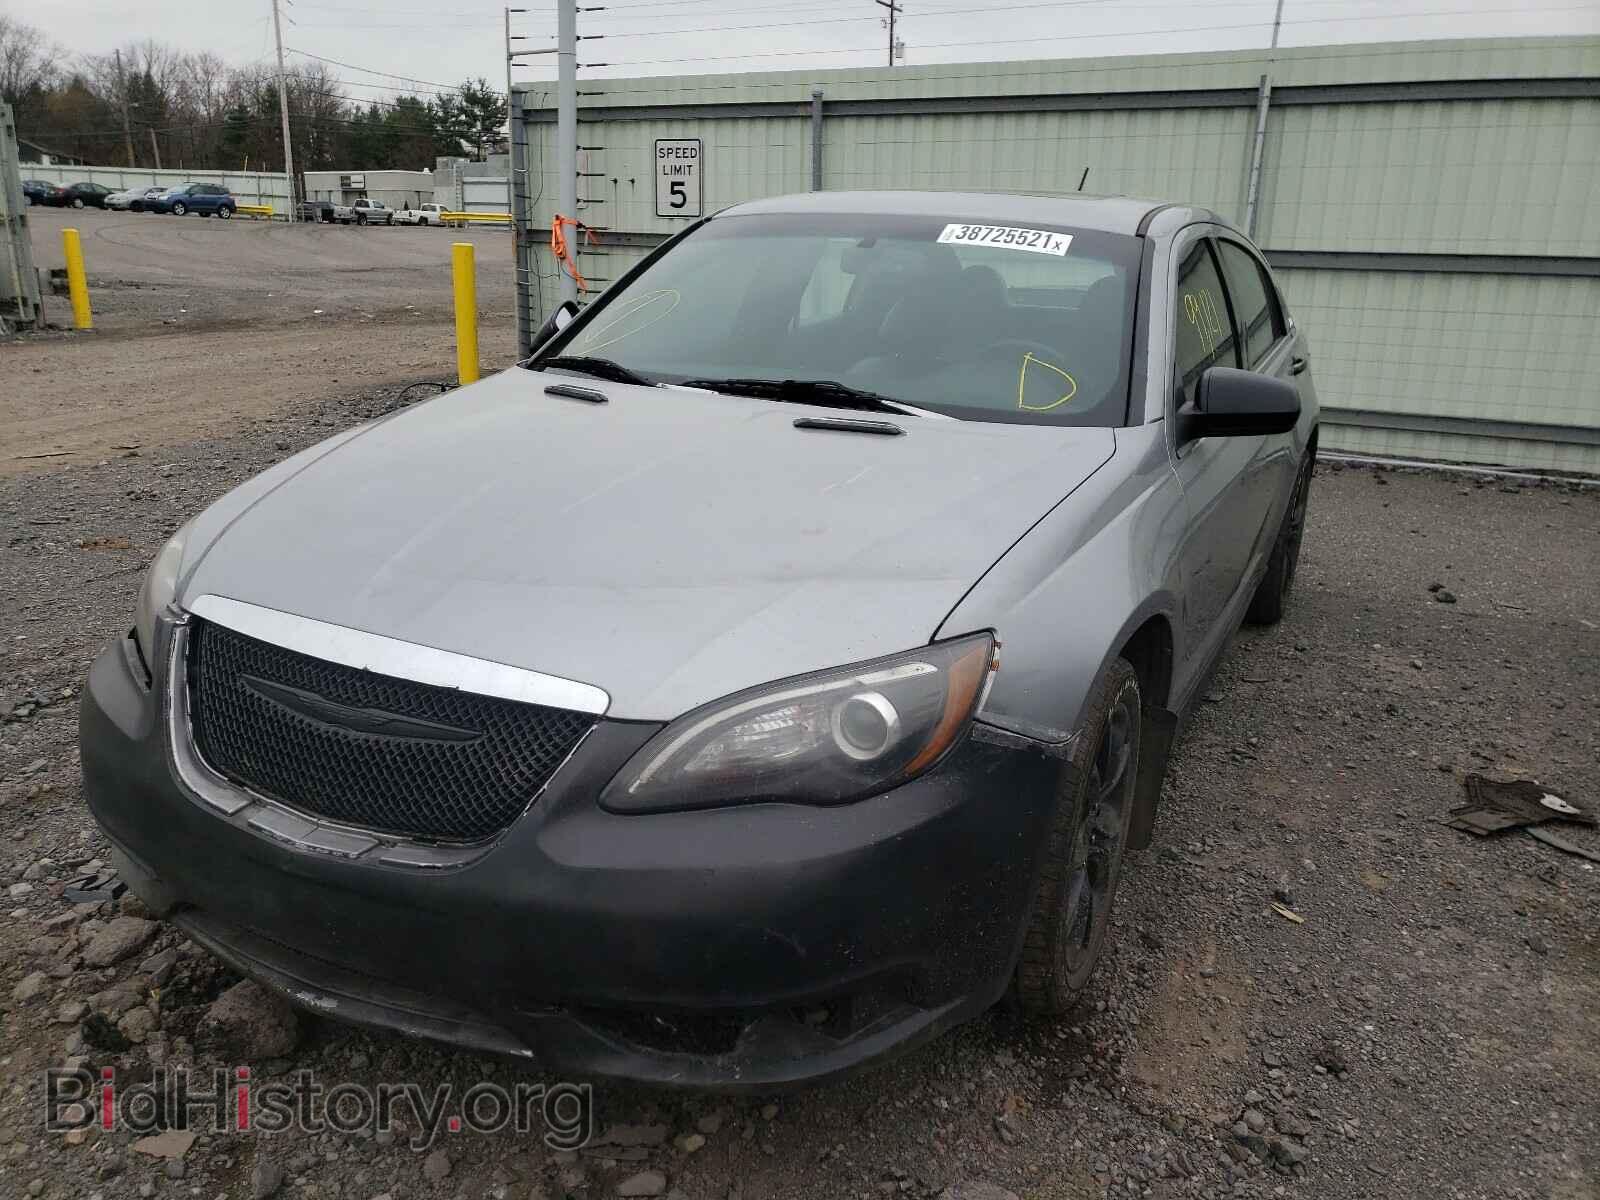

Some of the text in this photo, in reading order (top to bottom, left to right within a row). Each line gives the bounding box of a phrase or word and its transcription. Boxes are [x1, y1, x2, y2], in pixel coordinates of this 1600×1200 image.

[658, 147, 698, 158] SPEED
[663, 164, 693, 176] LIMIT
[670, 181, 687, 209] 5
